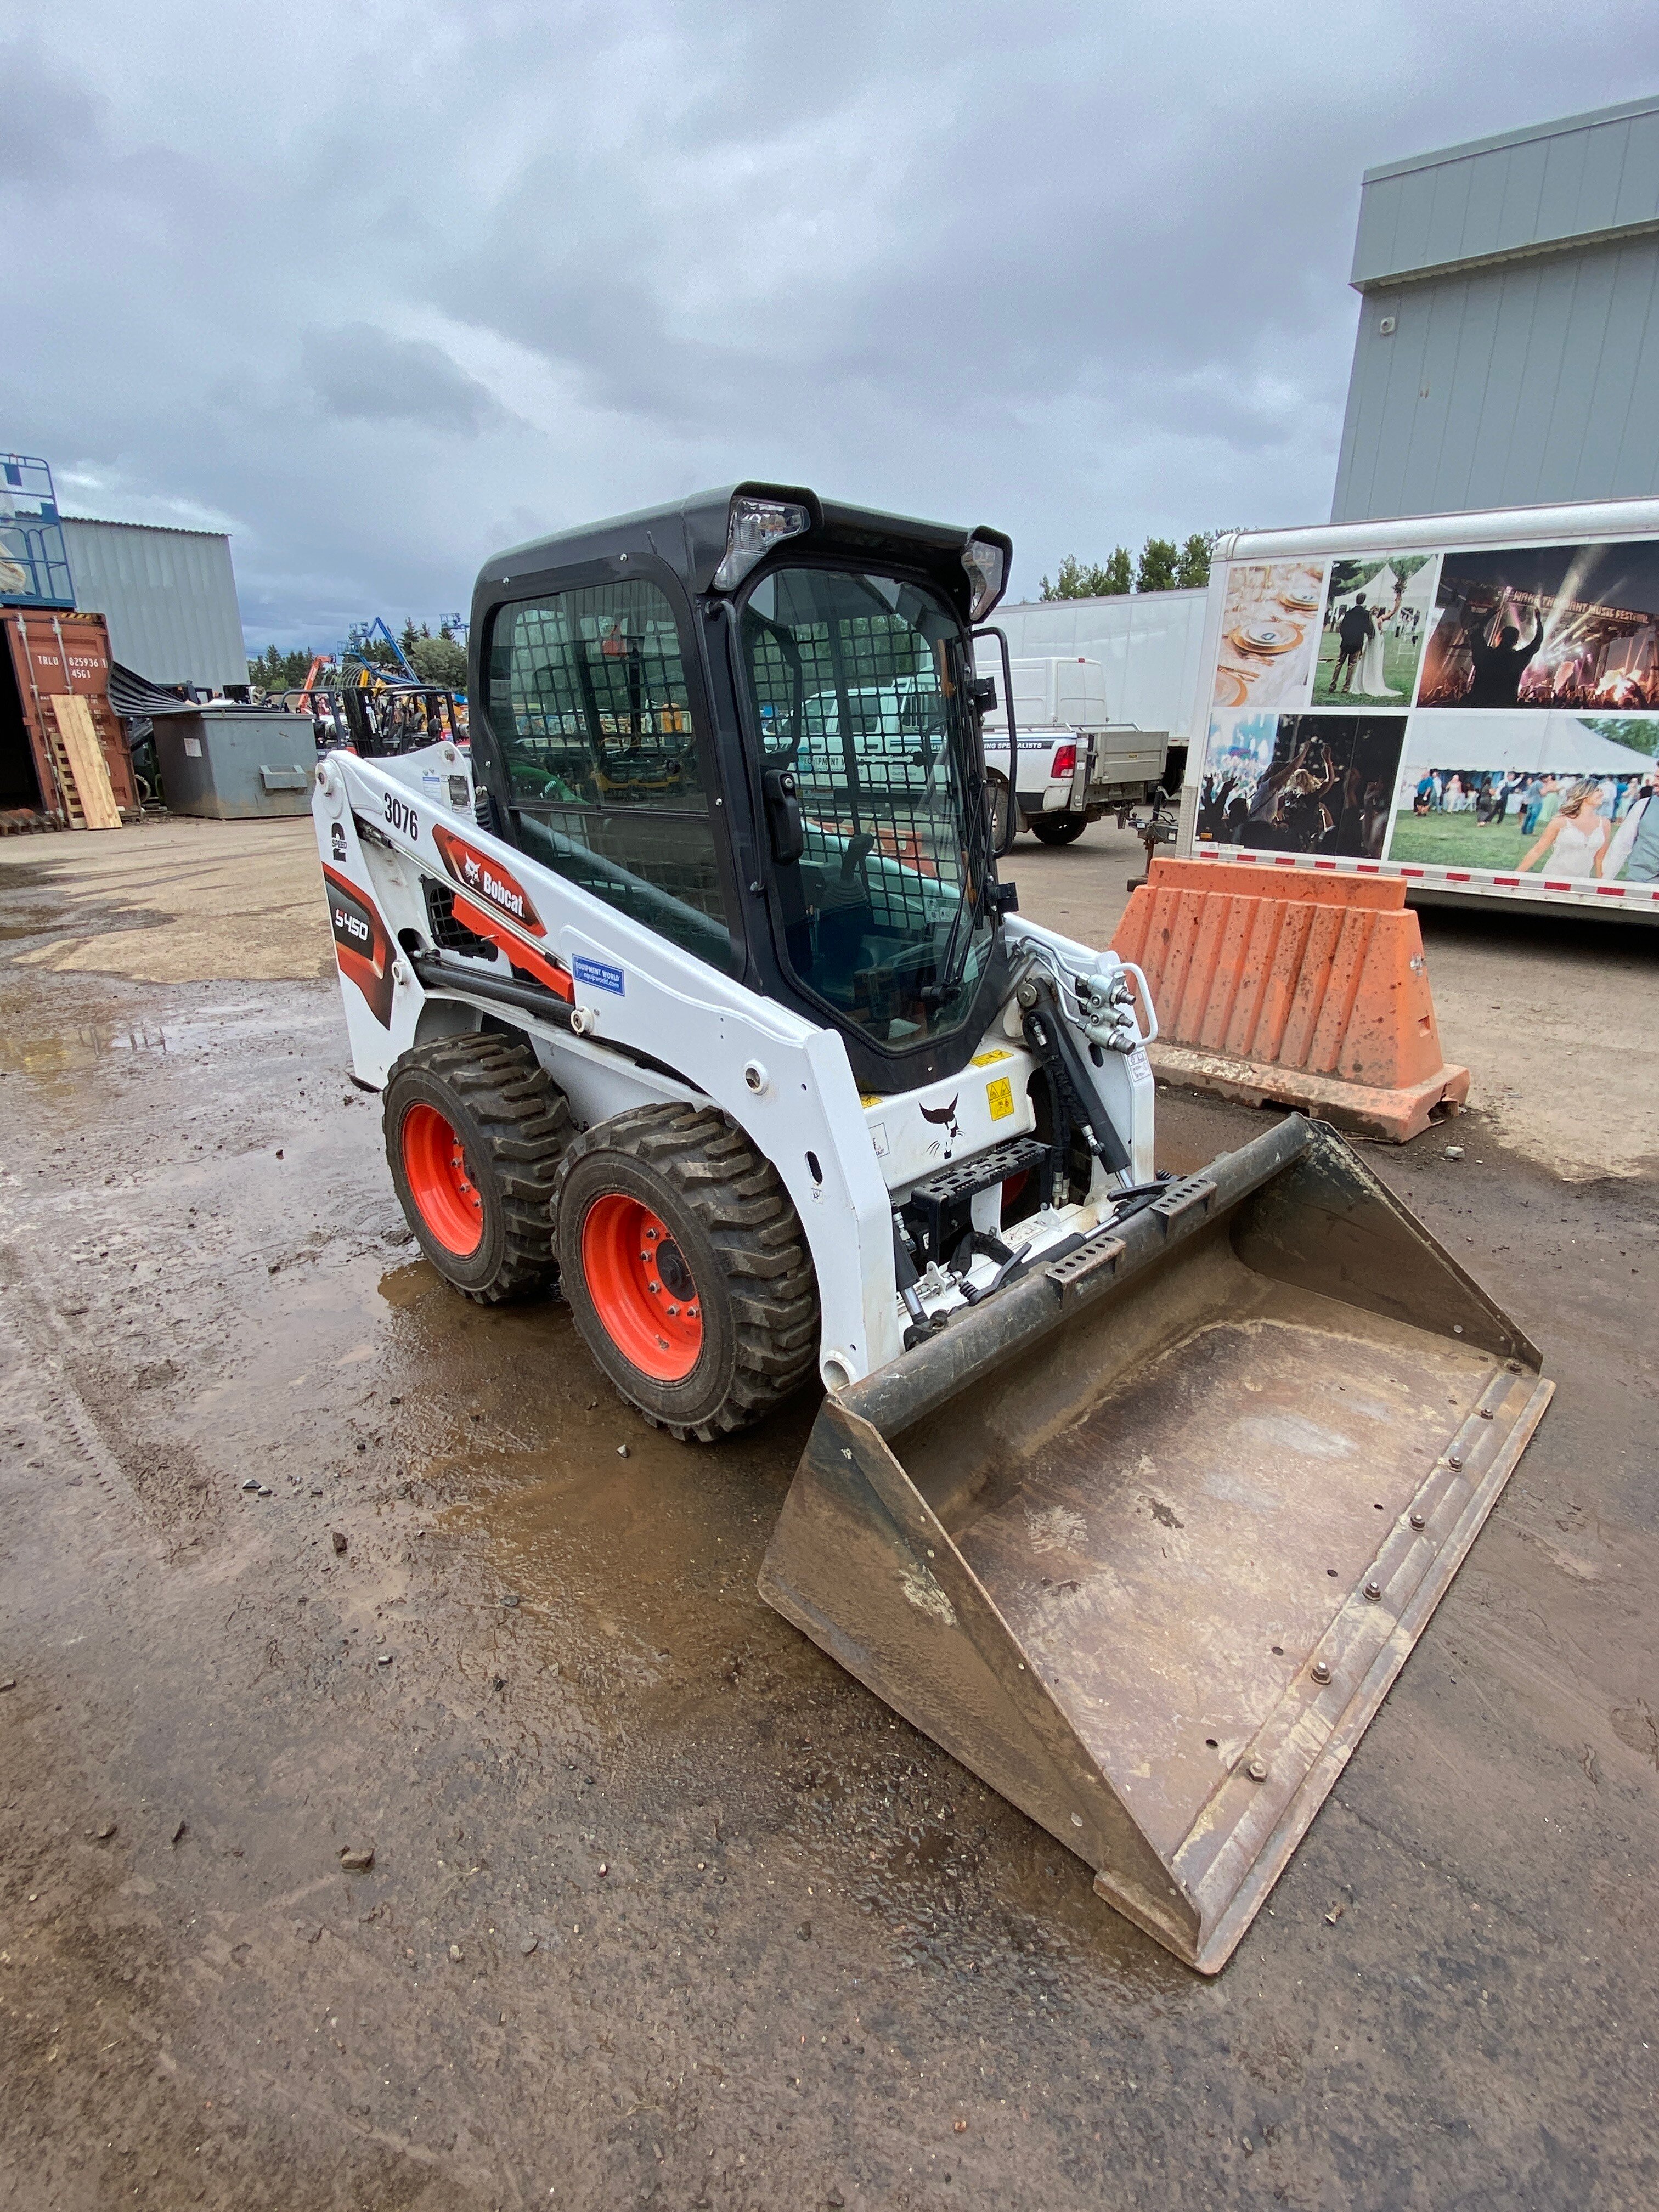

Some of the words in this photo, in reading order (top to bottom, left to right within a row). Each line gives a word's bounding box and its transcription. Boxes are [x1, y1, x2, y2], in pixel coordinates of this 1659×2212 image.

[1513, 591, 1538, 603] WAK
[38, 656, 59, 665] TRLU
[69, 657, 99, 667] 825936
[71, 669, 91, 679] 45G1
[804, 758, 838, 766] EQIPMNT
[384, 792, 419, 841] 3076
[331, 838, 347, 849] SPEED
[483, 871, 523, 918] Bobcat
[335, 909, 369, 941] S450
[575, 961, 601, 976] EQUIPMENT
[602, 969, 620, 982] WORLD
